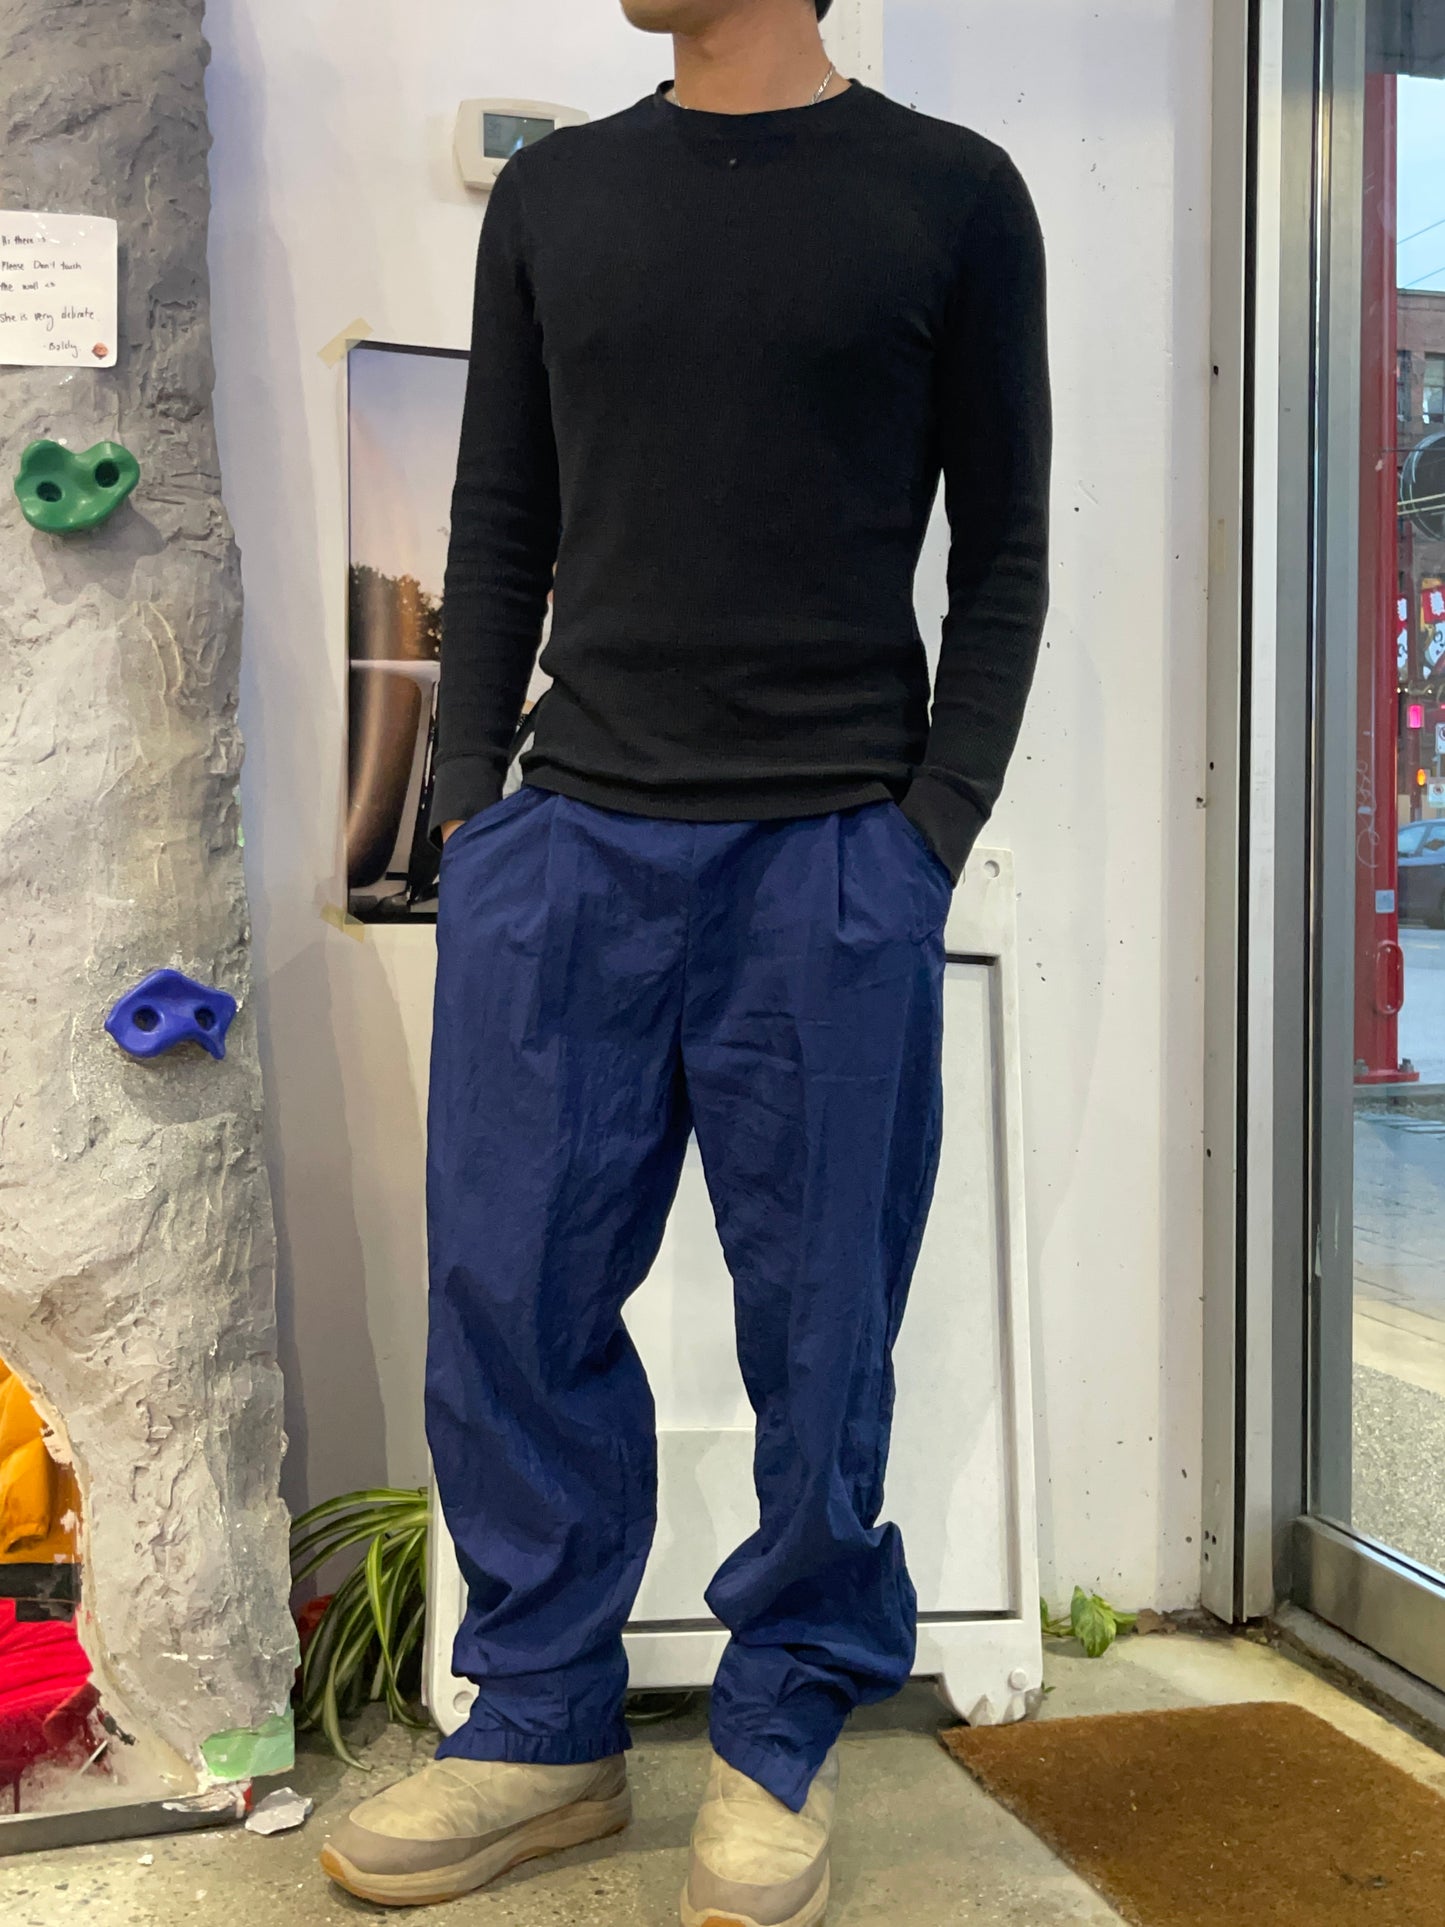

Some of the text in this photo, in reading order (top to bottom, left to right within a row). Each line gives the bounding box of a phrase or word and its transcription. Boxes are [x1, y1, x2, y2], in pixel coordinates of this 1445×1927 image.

[14, 235, 34, 245] there
[2, 260, 82, 271] Please Don't touch
[0, 282, 14, 292] the
[22, 281, 39, 290] wall
[0, 312, 16, 323] She
[20, 313, 28, 321] is
[34, 312, 54, 332] very
